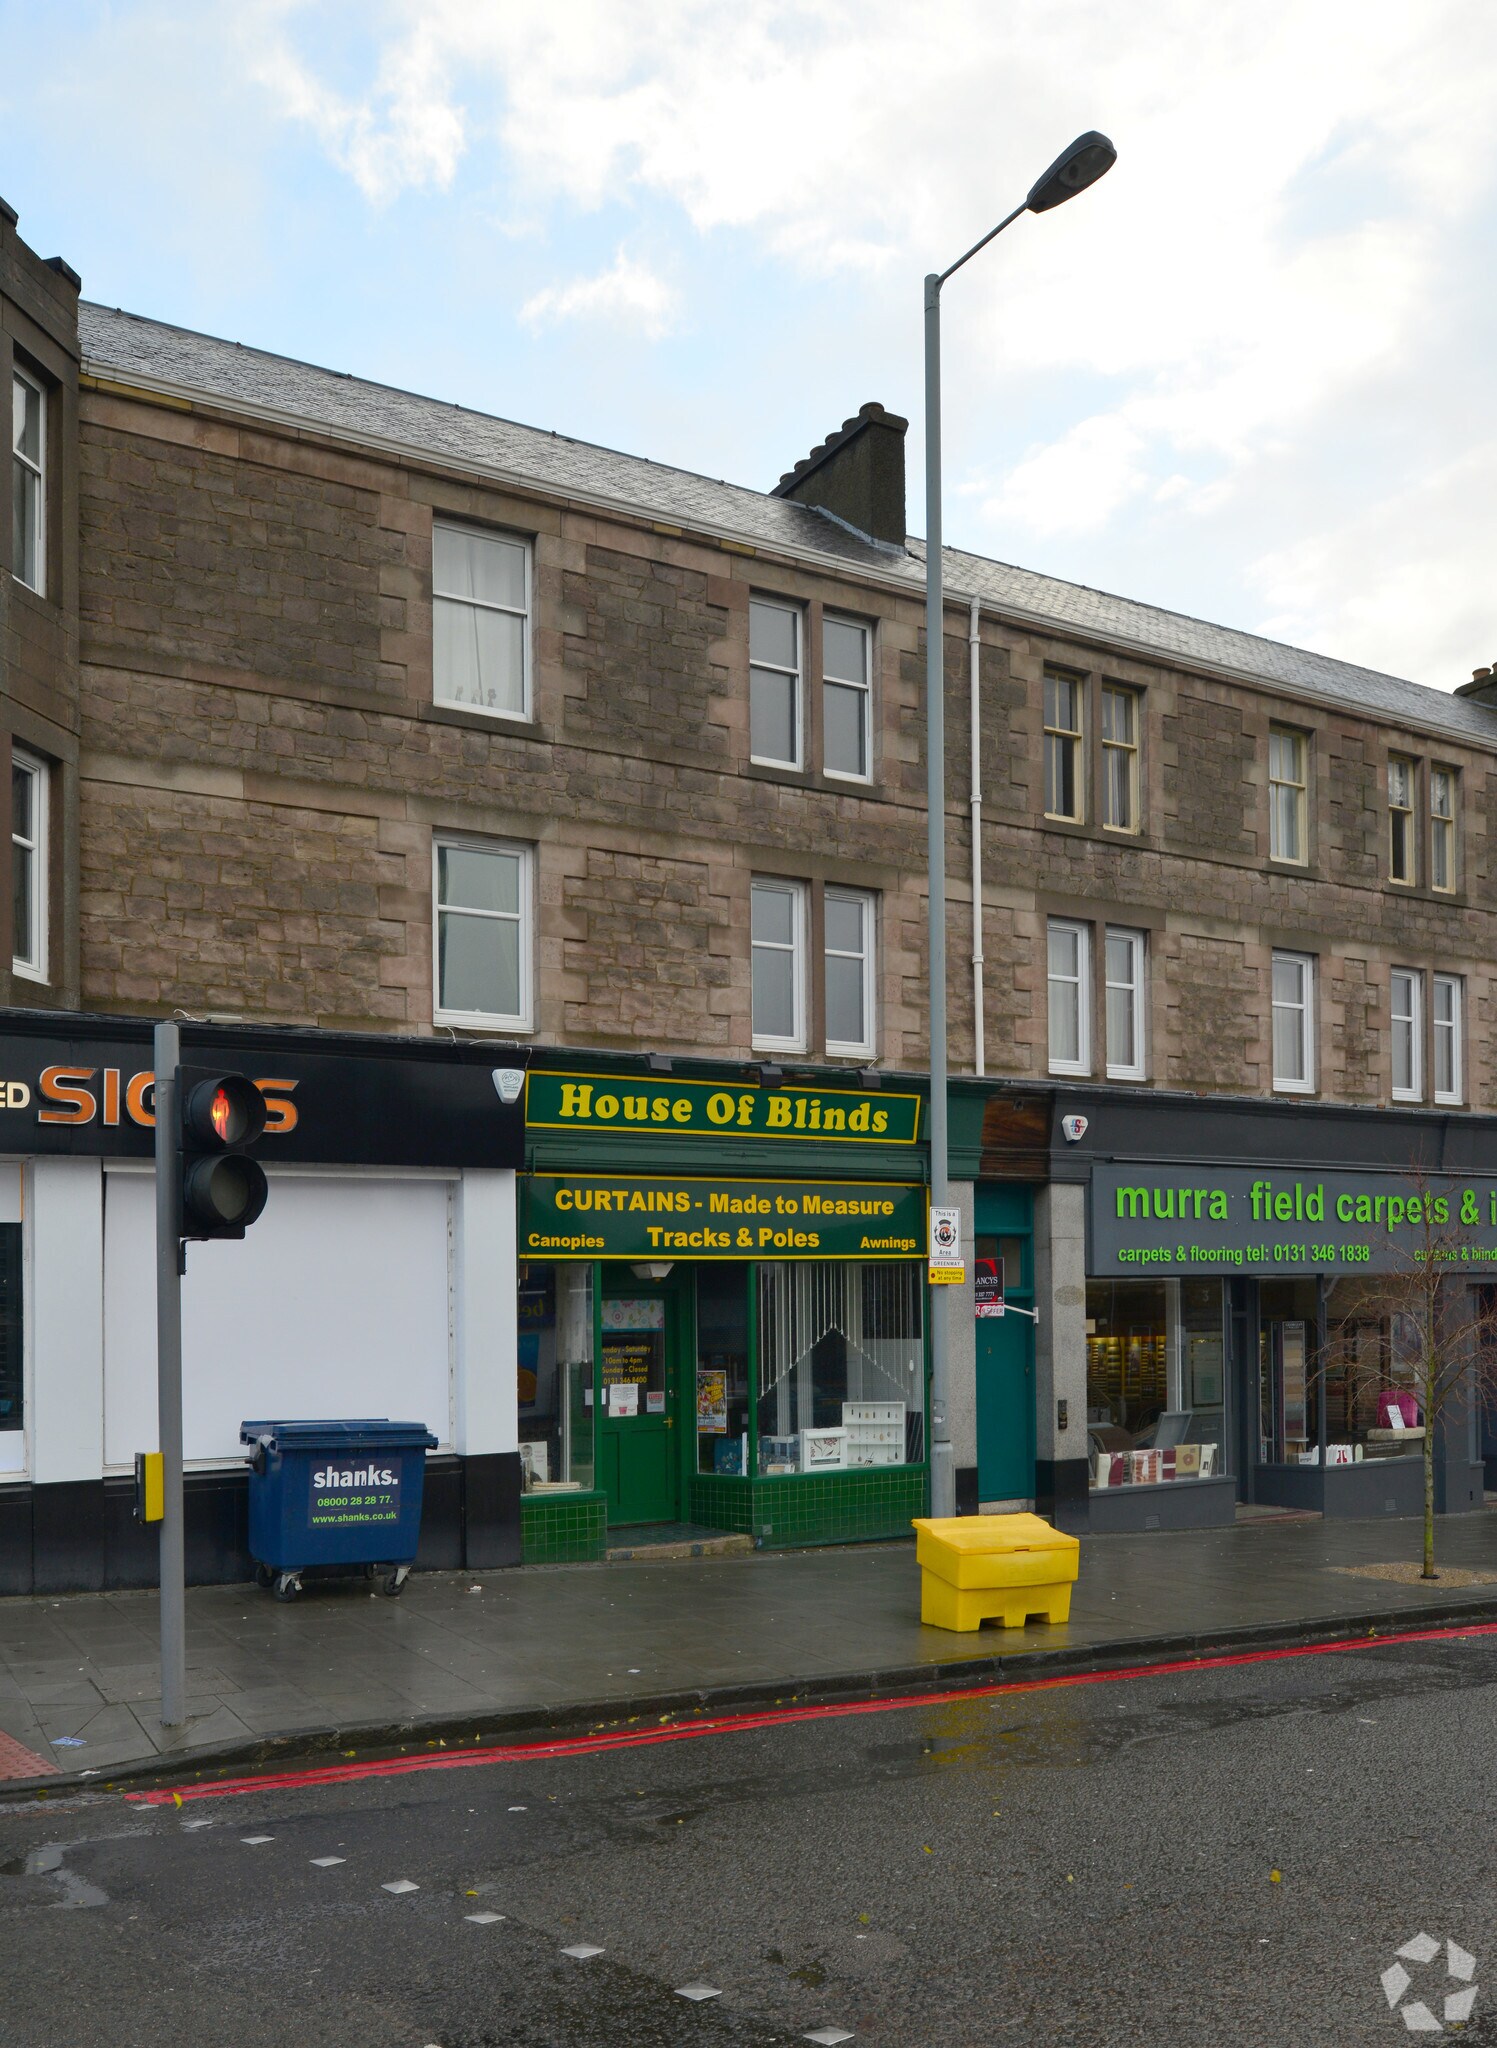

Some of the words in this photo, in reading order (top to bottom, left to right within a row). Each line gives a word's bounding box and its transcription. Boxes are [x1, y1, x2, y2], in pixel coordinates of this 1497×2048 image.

[38, 1065, 299, 1133] SIGS
[559, 1083, 692, 1122] House
[706, 1092, 755, 1126] Of
[766, 1096, 888, 1132] Blinds
[555, 1189, 690, 1212] CURTAINS
[709, 1193, 771, 1214] Made
[775, 1195, 798, 1214] to
[803, 1195, 894, 1215] Measure
[1116, 1187, 1228, 1220] murra
[1250, 1181, 1324, 1222] field
[1336, 1187, 1449, 1232] carpets
[1461, 1189, 1480, 1226] &
[528, 1233, 605, 1250] Canopies
[647, 1226, 730, 1247] Tracks
[736, 1227, 753, 1248] &
[759, 1228, 820, 1248] Poles
[860, 1236, 916, 1251] Awnings
[1118, 1246, 1172, 1265] carpets
[1176, 1245, 1187, 1261] &
[1190, 1245, 1243, 1265] flooring
[1246, 1244, 1269, 1261] tel:
[1273, 1244, 1306, 1262] 0131
[1311, 1244, 1335, 1262] 346
[1339, 1245, 1370, 1262] 1838
[976, 1276, 998, 1285] ANCYS
[603, 1346, 621, 1354] onday
[625, 1345, 651, 1353] Saturday
[602, 1366, 624, 1374] Sunday
[629, 1365, 648, 1373] Closed
[313, 1465, 398, 1488] shanks.
[317, 1497, 348, 1507] 08000
[350, 1497, 362, 1506] 28
[365, 1496, 377, 1505] 28
[312, 1511, 396, 1523] www.shanks.co.uk
